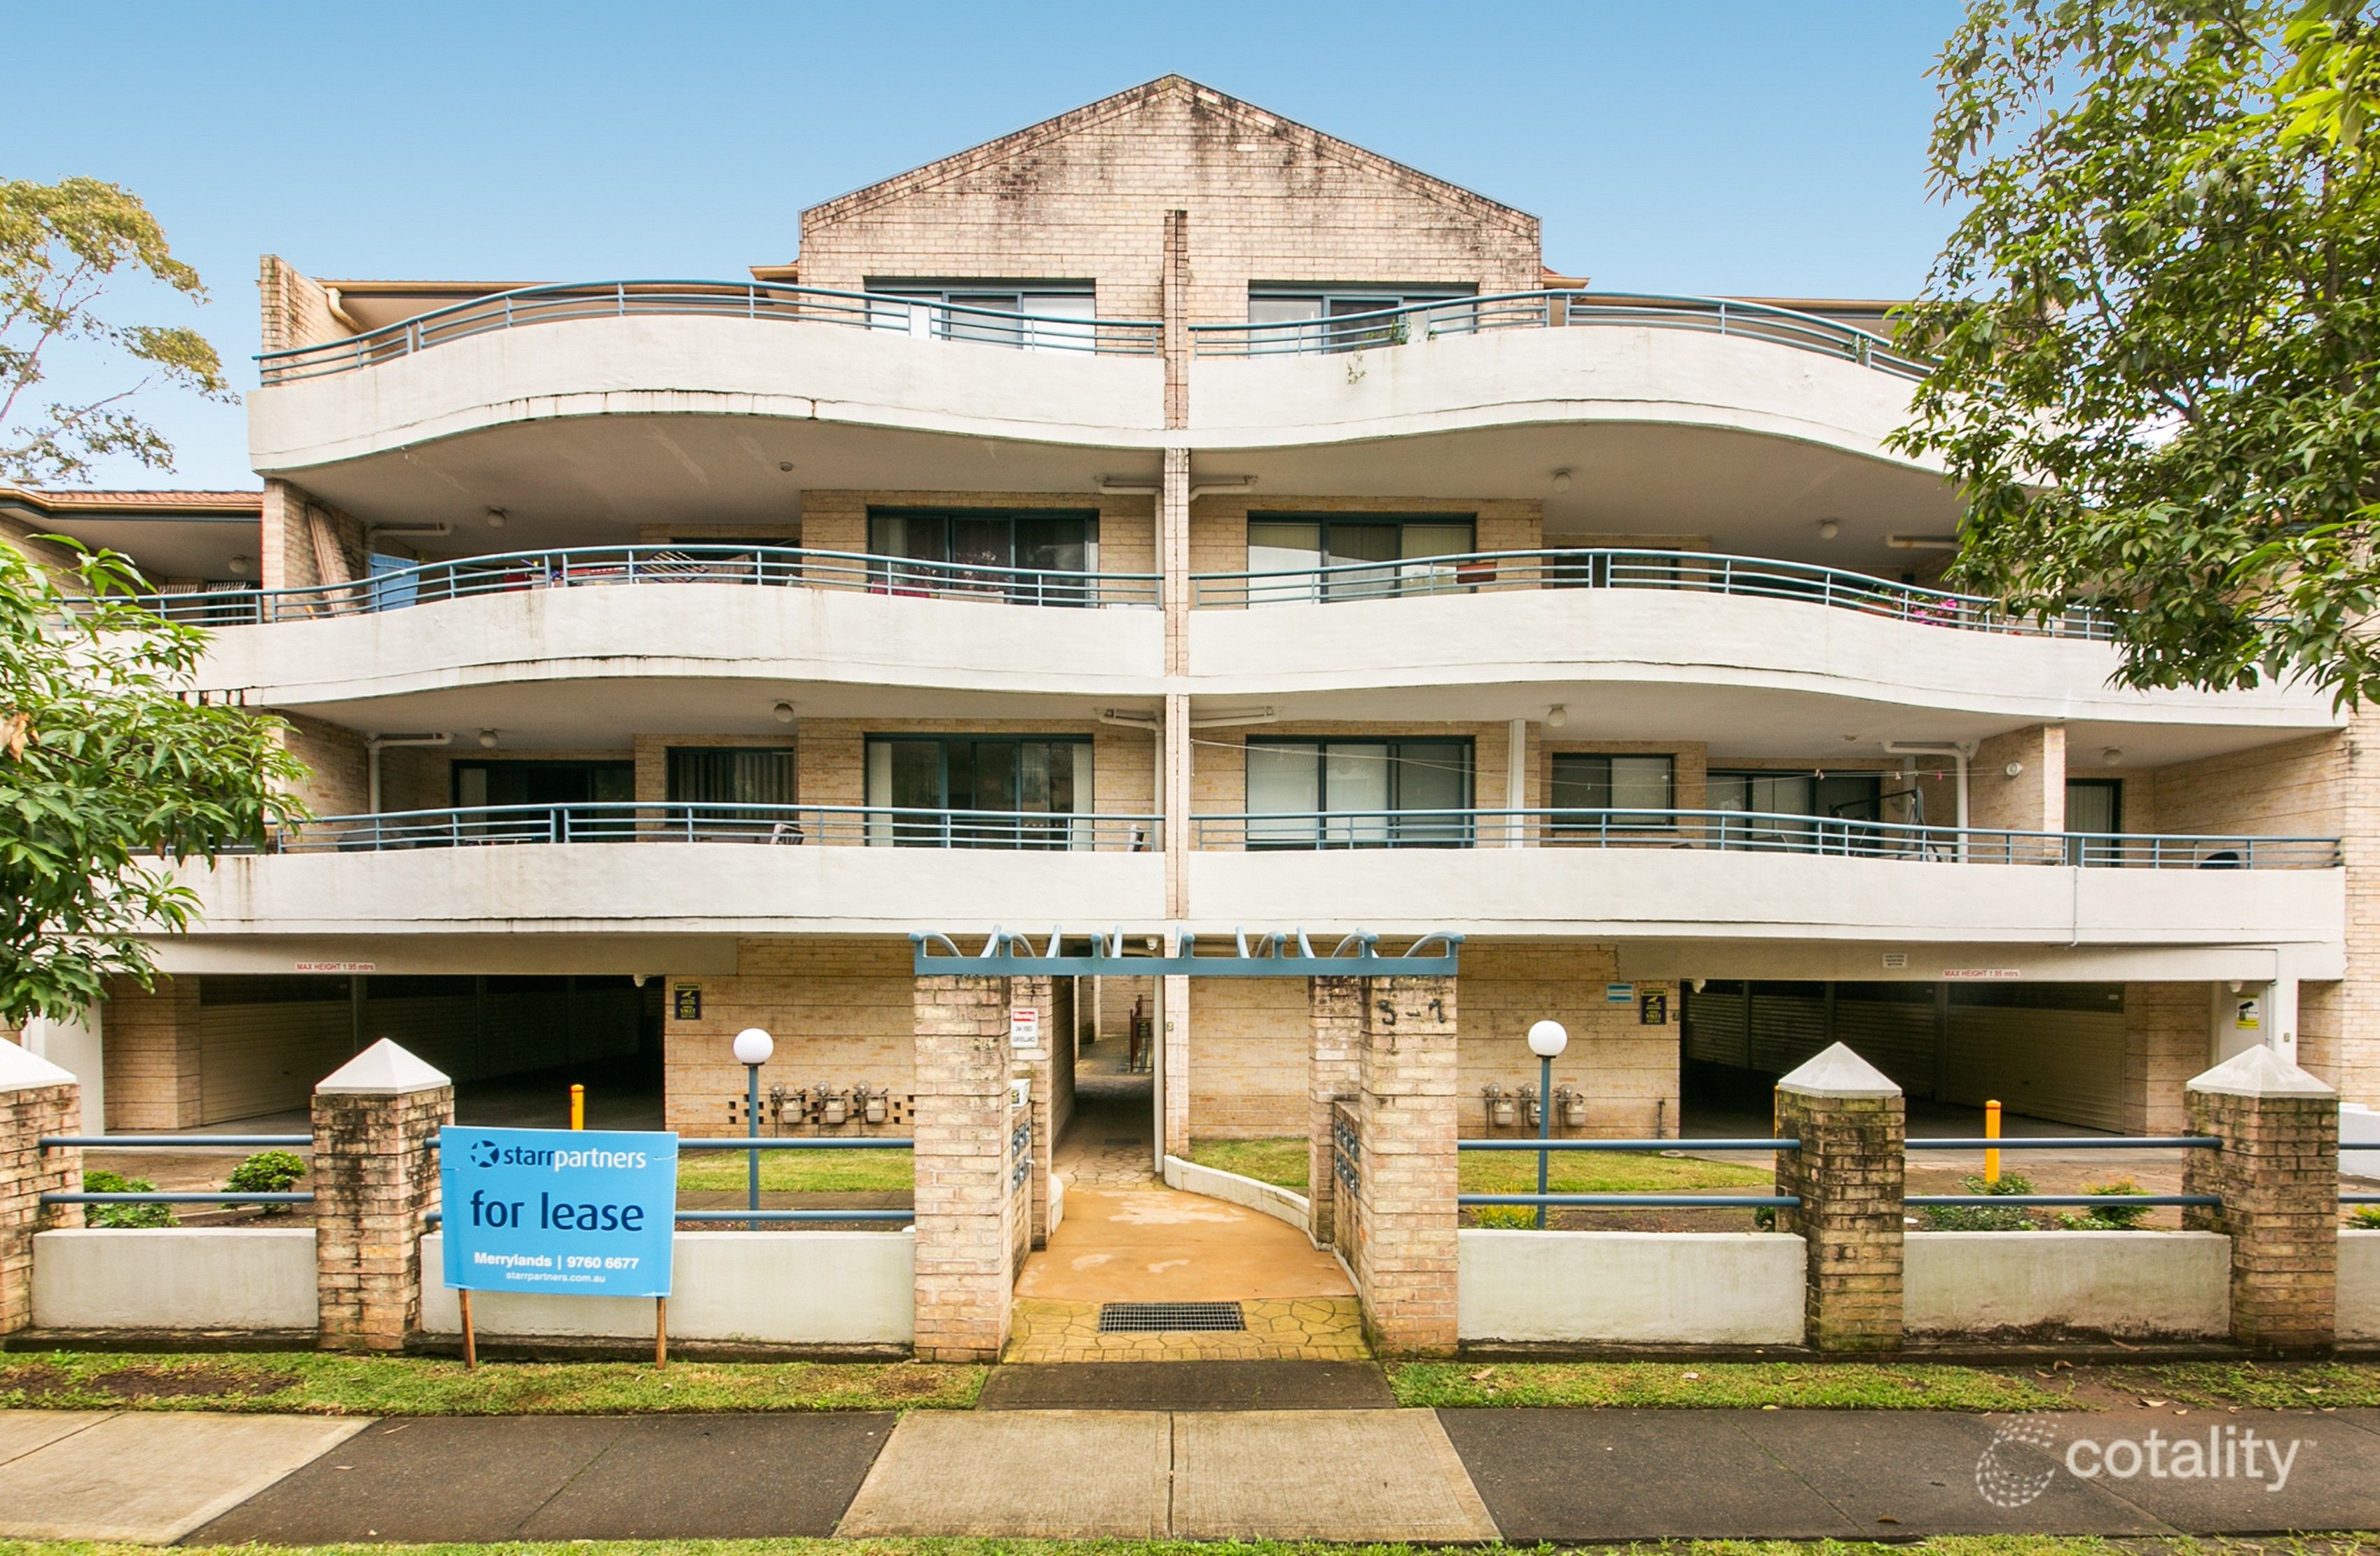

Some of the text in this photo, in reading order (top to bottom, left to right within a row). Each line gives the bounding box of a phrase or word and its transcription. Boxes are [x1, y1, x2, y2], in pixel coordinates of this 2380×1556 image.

[1013, 1012, 1035, 1021] Warning
[504, 1145, 646, 1172] starrpartners
[470, 1190, 644, 1232] for lease
[474, 1252, 552, 1268] Merrylands
[566, 1256, 601, 1269] 9760
[604, 1257, 639, 1269] 6677
[505, 1270, 606, 1283] starrpartners.com.au
